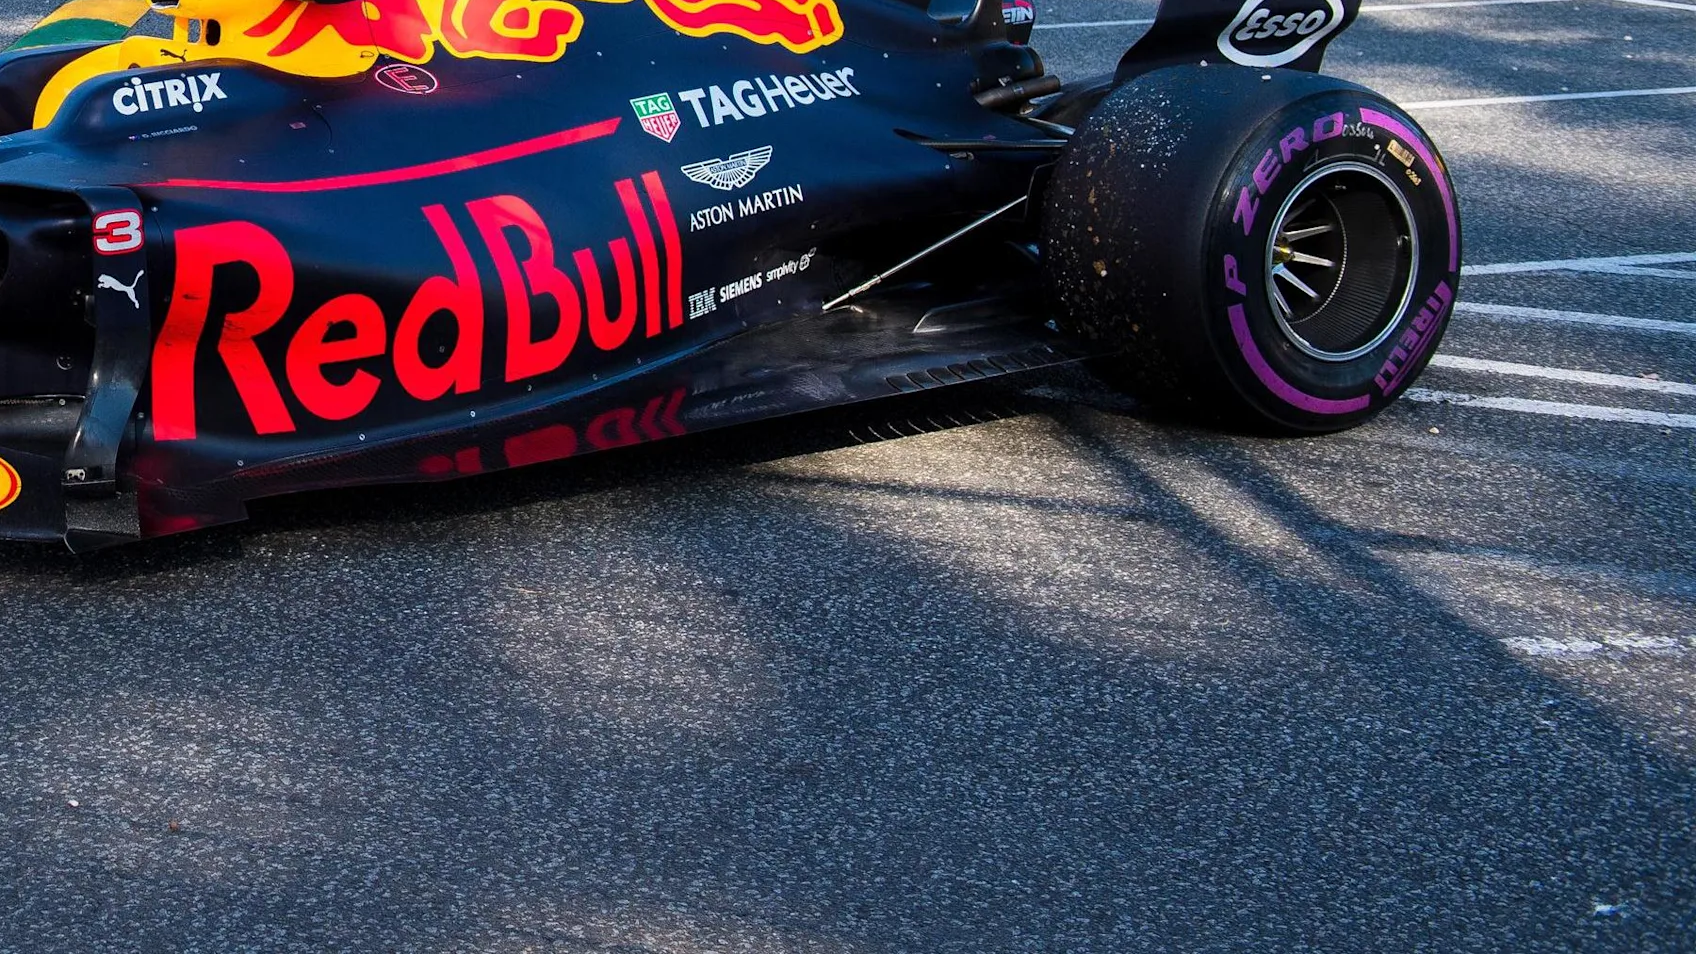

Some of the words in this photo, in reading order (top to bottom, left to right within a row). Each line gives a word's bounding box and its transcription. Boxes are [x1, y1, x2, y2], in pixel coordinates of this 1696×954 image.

[636, 96, 671, 114] TAG
[641, 115, 680, 139] HEUER
[1233, 111, 1344, 236] ZERO
[690, 202, 734, 232] ASTON
[739, 183, 804, 217] MARTIN
[93, 209, 144, 255] 3
[720, 272, 762, 303] SIEMENS
[1224, 253, 1246, 296] P
[152, 203, 484, 442] Red
[466, 170, 684, 382] Bull
[688, 286, 717, 319] IBM
[1374, 281, 1453, 397] PIRELLI
